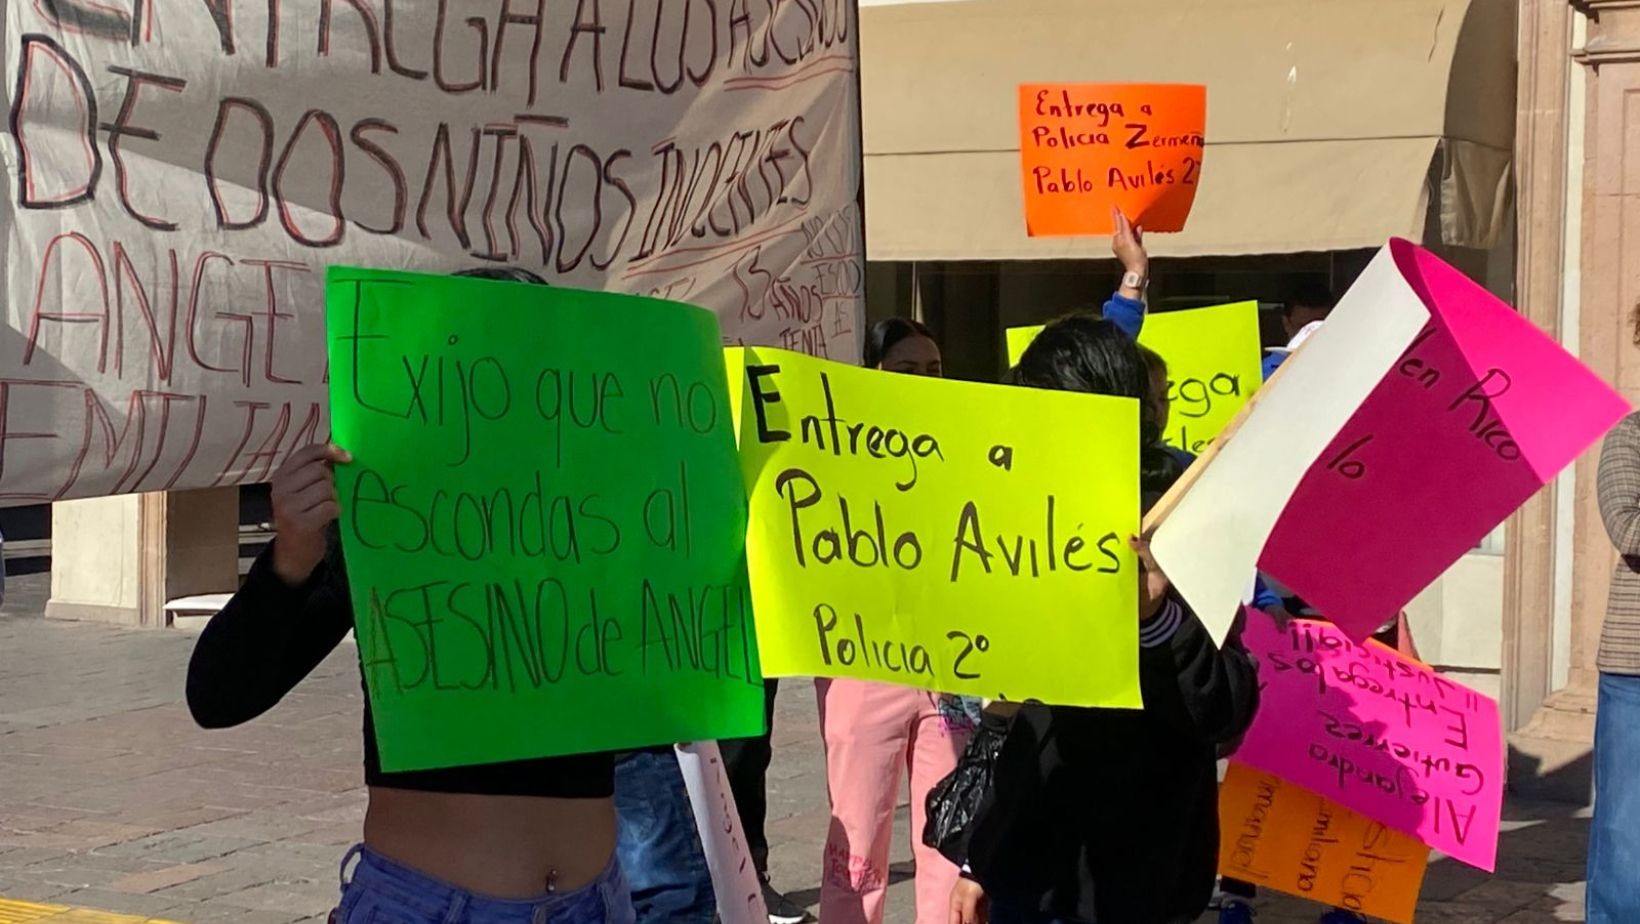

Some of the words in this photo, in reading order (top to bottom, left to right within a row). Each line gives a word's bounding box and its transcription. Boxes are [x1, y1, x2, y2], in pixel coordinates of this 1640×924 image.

[9, 33, 187, 231] DE
[204, 97, 408, 248] DOS
[416, 114, 638, 274] NIÑOS
[1036, 89, 1124, 127] Entrega
[1141, 104, 1152, 115] a
[1032, 166, 1093, 194] Pablo
[1109, 160, 1175, 191] Avilés
[23, 231, 330, 388] ANGE
[332, 278, 511, 467] Exijo
[536, 368, 623, 468] que
[649, 371, 717, 434] no
[1448, 367, 1521, 461] Rico
[746, 365, 944, 491] Entrega
[988, 445, 1013, 471] a
[351, 469, 621, 564] escondas
[643, 460, 691, 559] al
[775, 468, 922, 570] Pablo
[950, 494, 1121, 583] Avilés
[365, 577, 569, 699] ASESINO
[575, 586, 624, 677] de
[634, 578, 766, 687] ANGEL
[813, 603, 935, 677] Policia
[1268, 652, 1468, 751] Entregalos
[1317, 710, 1485, 796] Gutierrez
[1309, 743, 1477, 845] Alejandro
